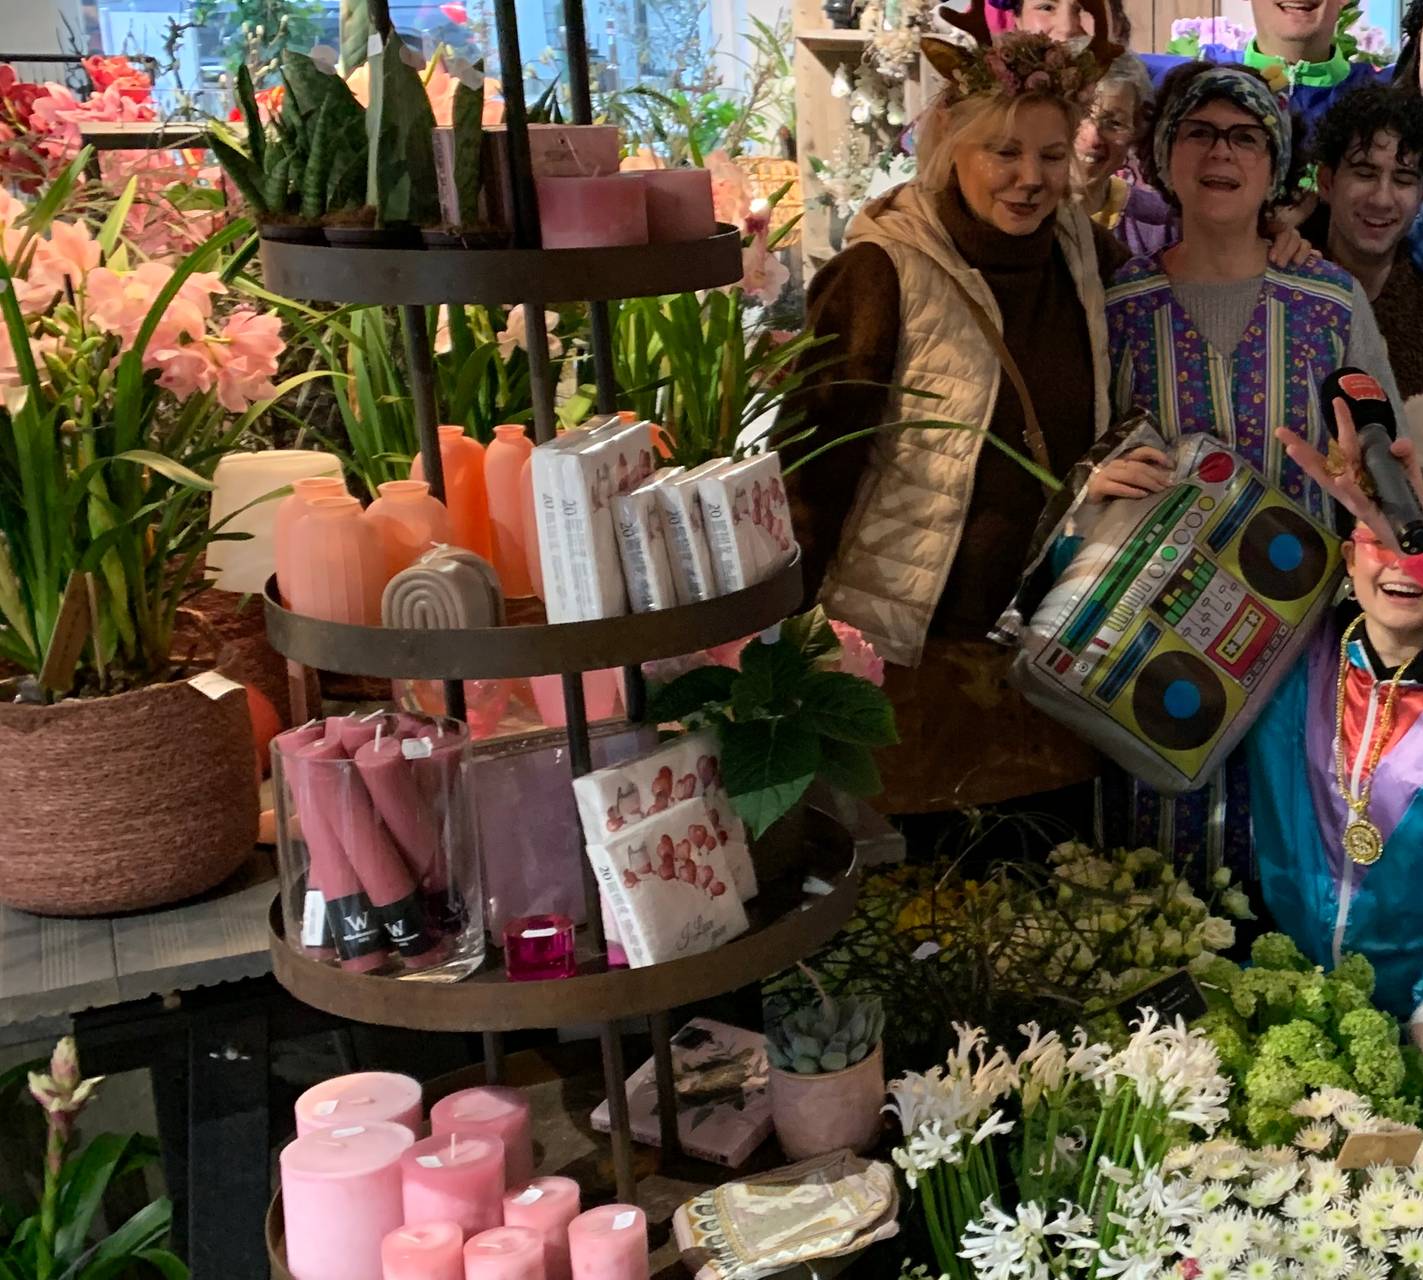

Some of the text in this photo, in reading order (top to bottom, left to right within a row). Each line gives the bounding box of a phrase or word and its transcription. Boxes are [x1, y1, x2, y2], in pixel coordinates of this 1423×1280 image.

[562, 499, 577, 516] 20
[708, 503, 721, 518] 20
[620, 522, 635, 538] 20
[598, 865, 612, 881] 20
[345, 911, 368, 931] W
[384, 919, 403, 937] W
